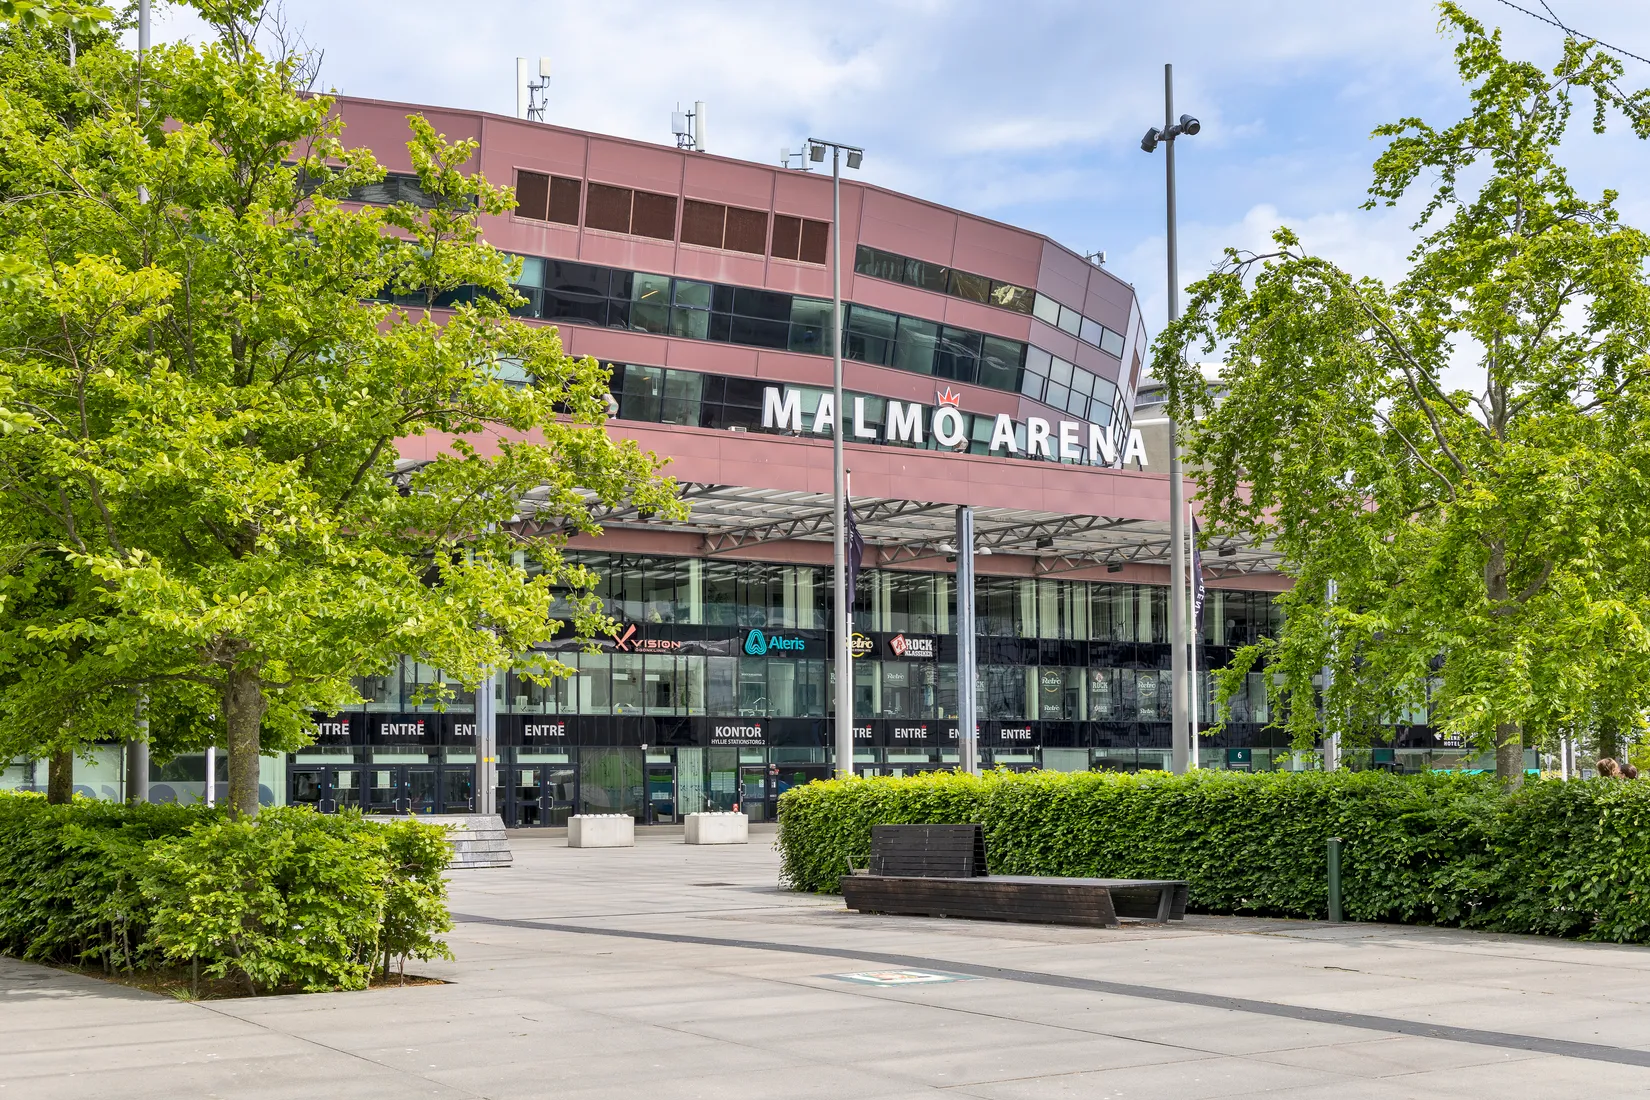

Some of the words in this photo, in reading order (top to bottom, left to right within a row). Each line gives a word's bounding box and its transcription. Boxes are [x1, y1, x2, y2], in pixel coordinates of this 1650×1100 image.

[989, 413, 1149, 466] ARENA
[769, 636, 805, 650] Aleris
[905, 639, 933, 651] ROCK
[455, 724, 477, 736] ENT
[715, 726, 762, 738] KONTOR
[853, 728, 872, 738] TRE
[1237, 751, 1243, 759] 6
